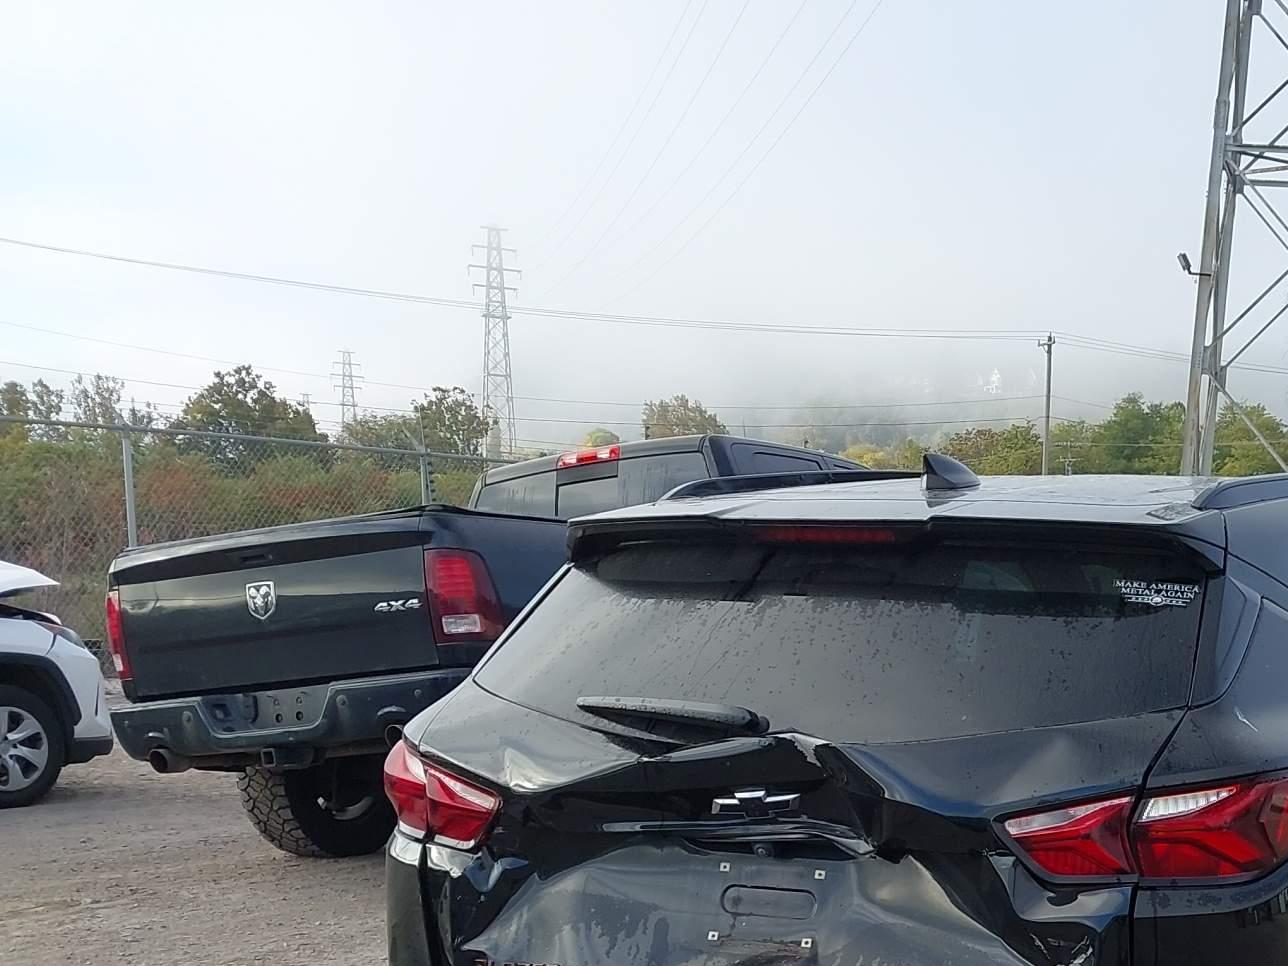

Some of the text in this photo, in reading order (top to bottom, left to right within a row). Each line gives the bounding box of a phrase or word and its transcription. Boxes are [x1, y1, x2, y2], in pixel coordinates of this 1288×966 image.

[1115, 580, 1200, 593] MAKE AMERICA
[1120, 587, 1195, 599] METAL AGAIN
